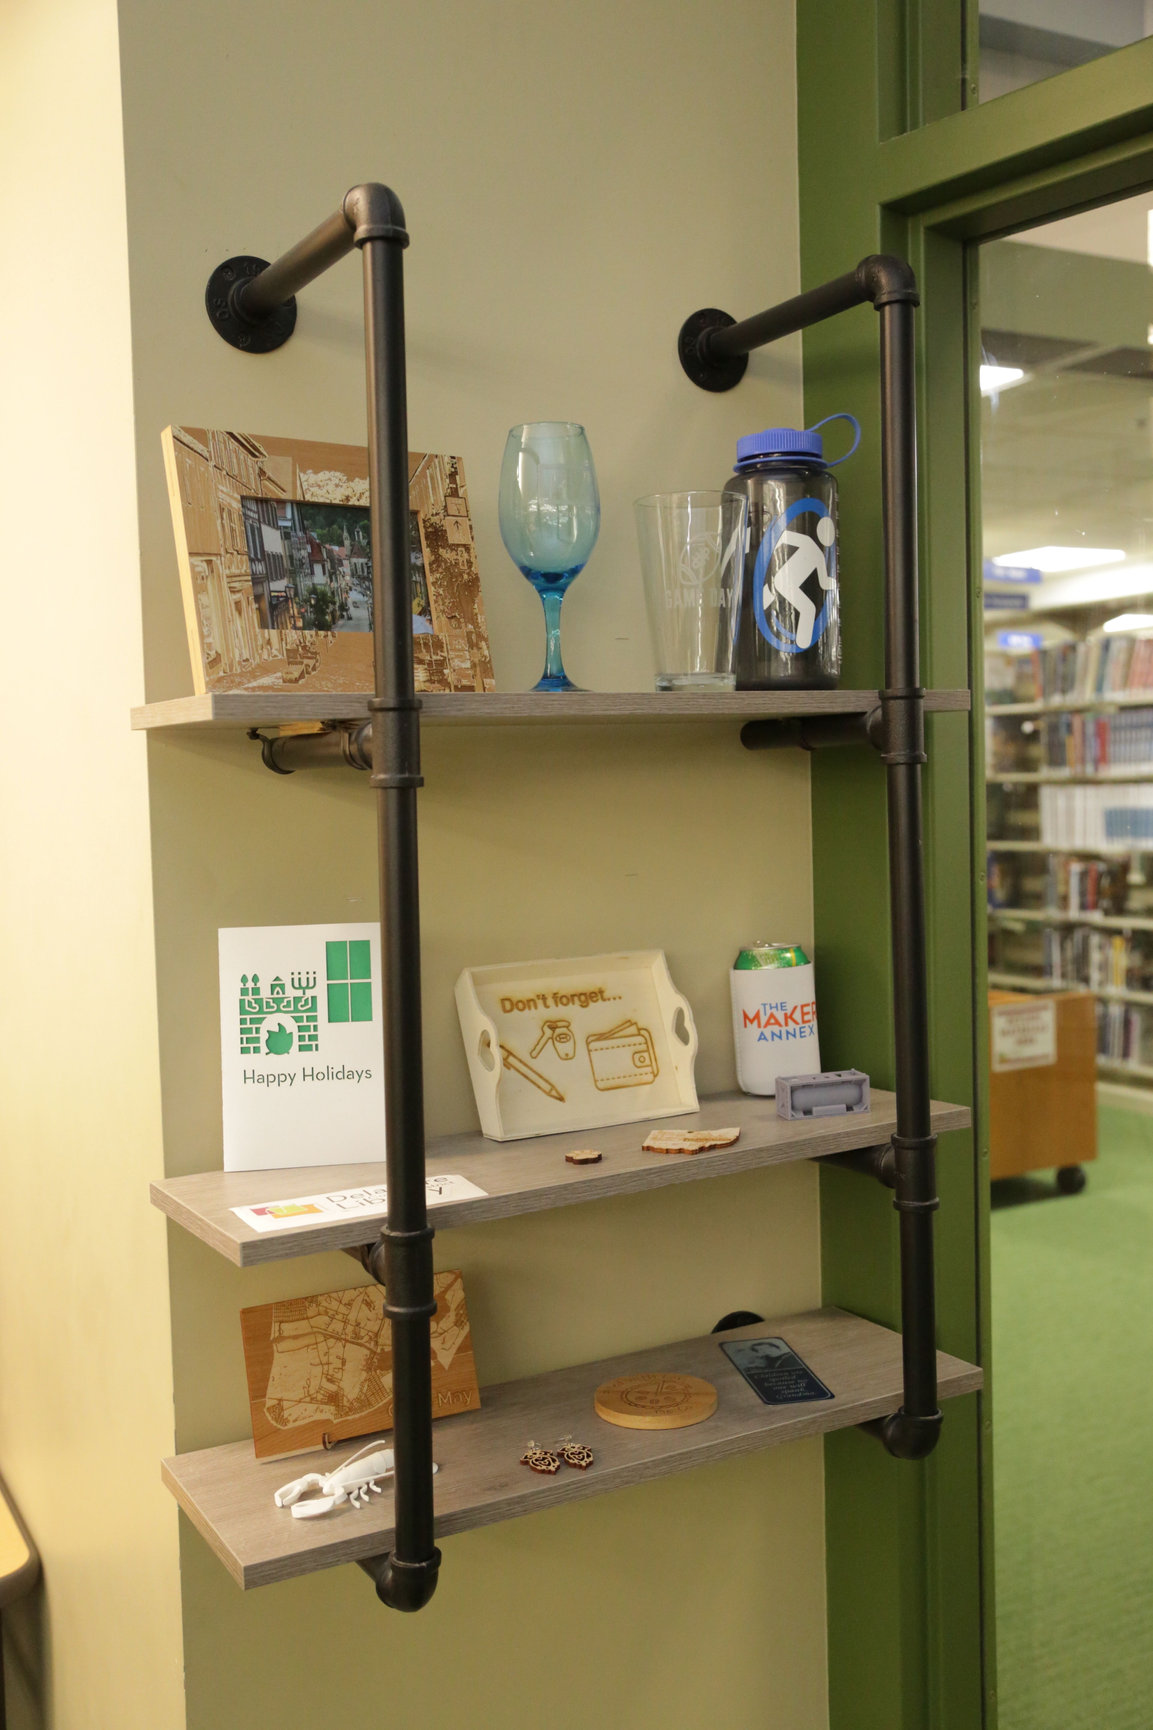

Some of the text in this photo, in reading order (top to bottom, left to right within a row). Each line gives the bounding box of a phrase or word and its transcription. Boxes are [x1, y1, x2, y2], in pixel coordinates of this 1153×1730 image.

[710, 588, 734, 608] DAY
[500, 987, 623, 1014] Don't forget...
[761, 1001, 788, 1016] THE
[742, 1001, 817, 1029] MAKER
[757, 1024, 815, 1042] ANNEX
[243, 1064, 373, 1088] Happy Holidays
